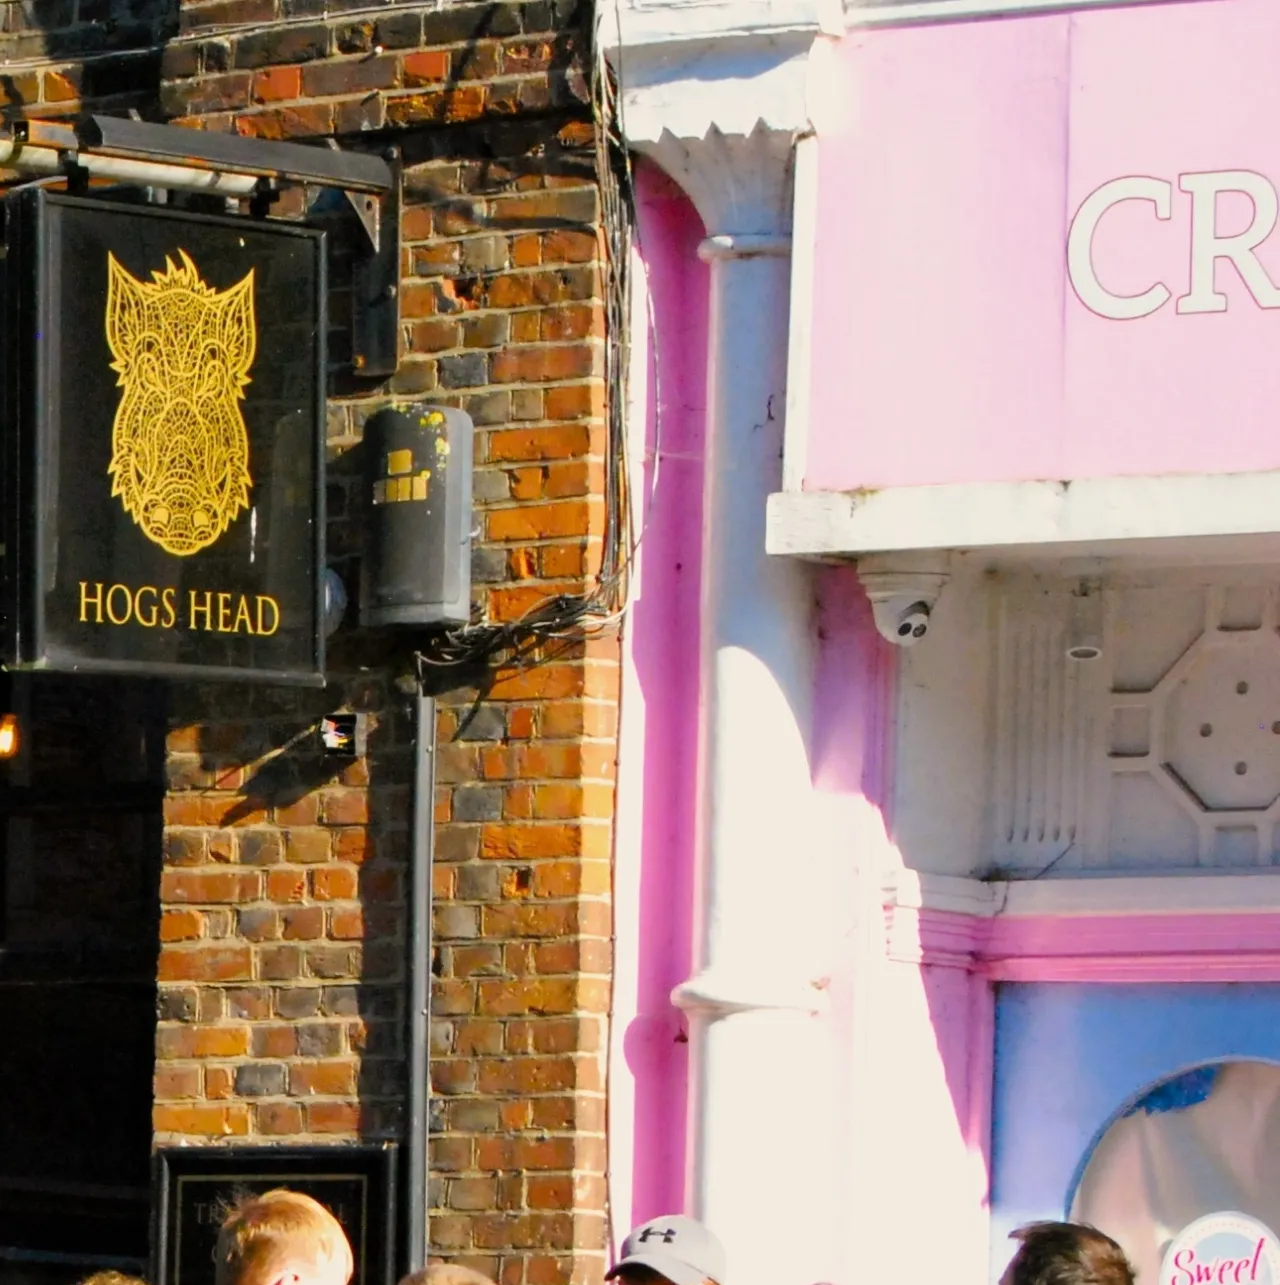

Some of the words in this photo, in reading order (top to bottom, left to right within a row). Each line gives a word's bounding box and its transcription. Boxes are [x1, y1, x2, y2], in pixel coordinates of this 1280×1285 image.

[1067, 168, 1280, 320] CR
[78, 581, 177, 629] HOGS
[188, 590, 281, 636] HEAD
